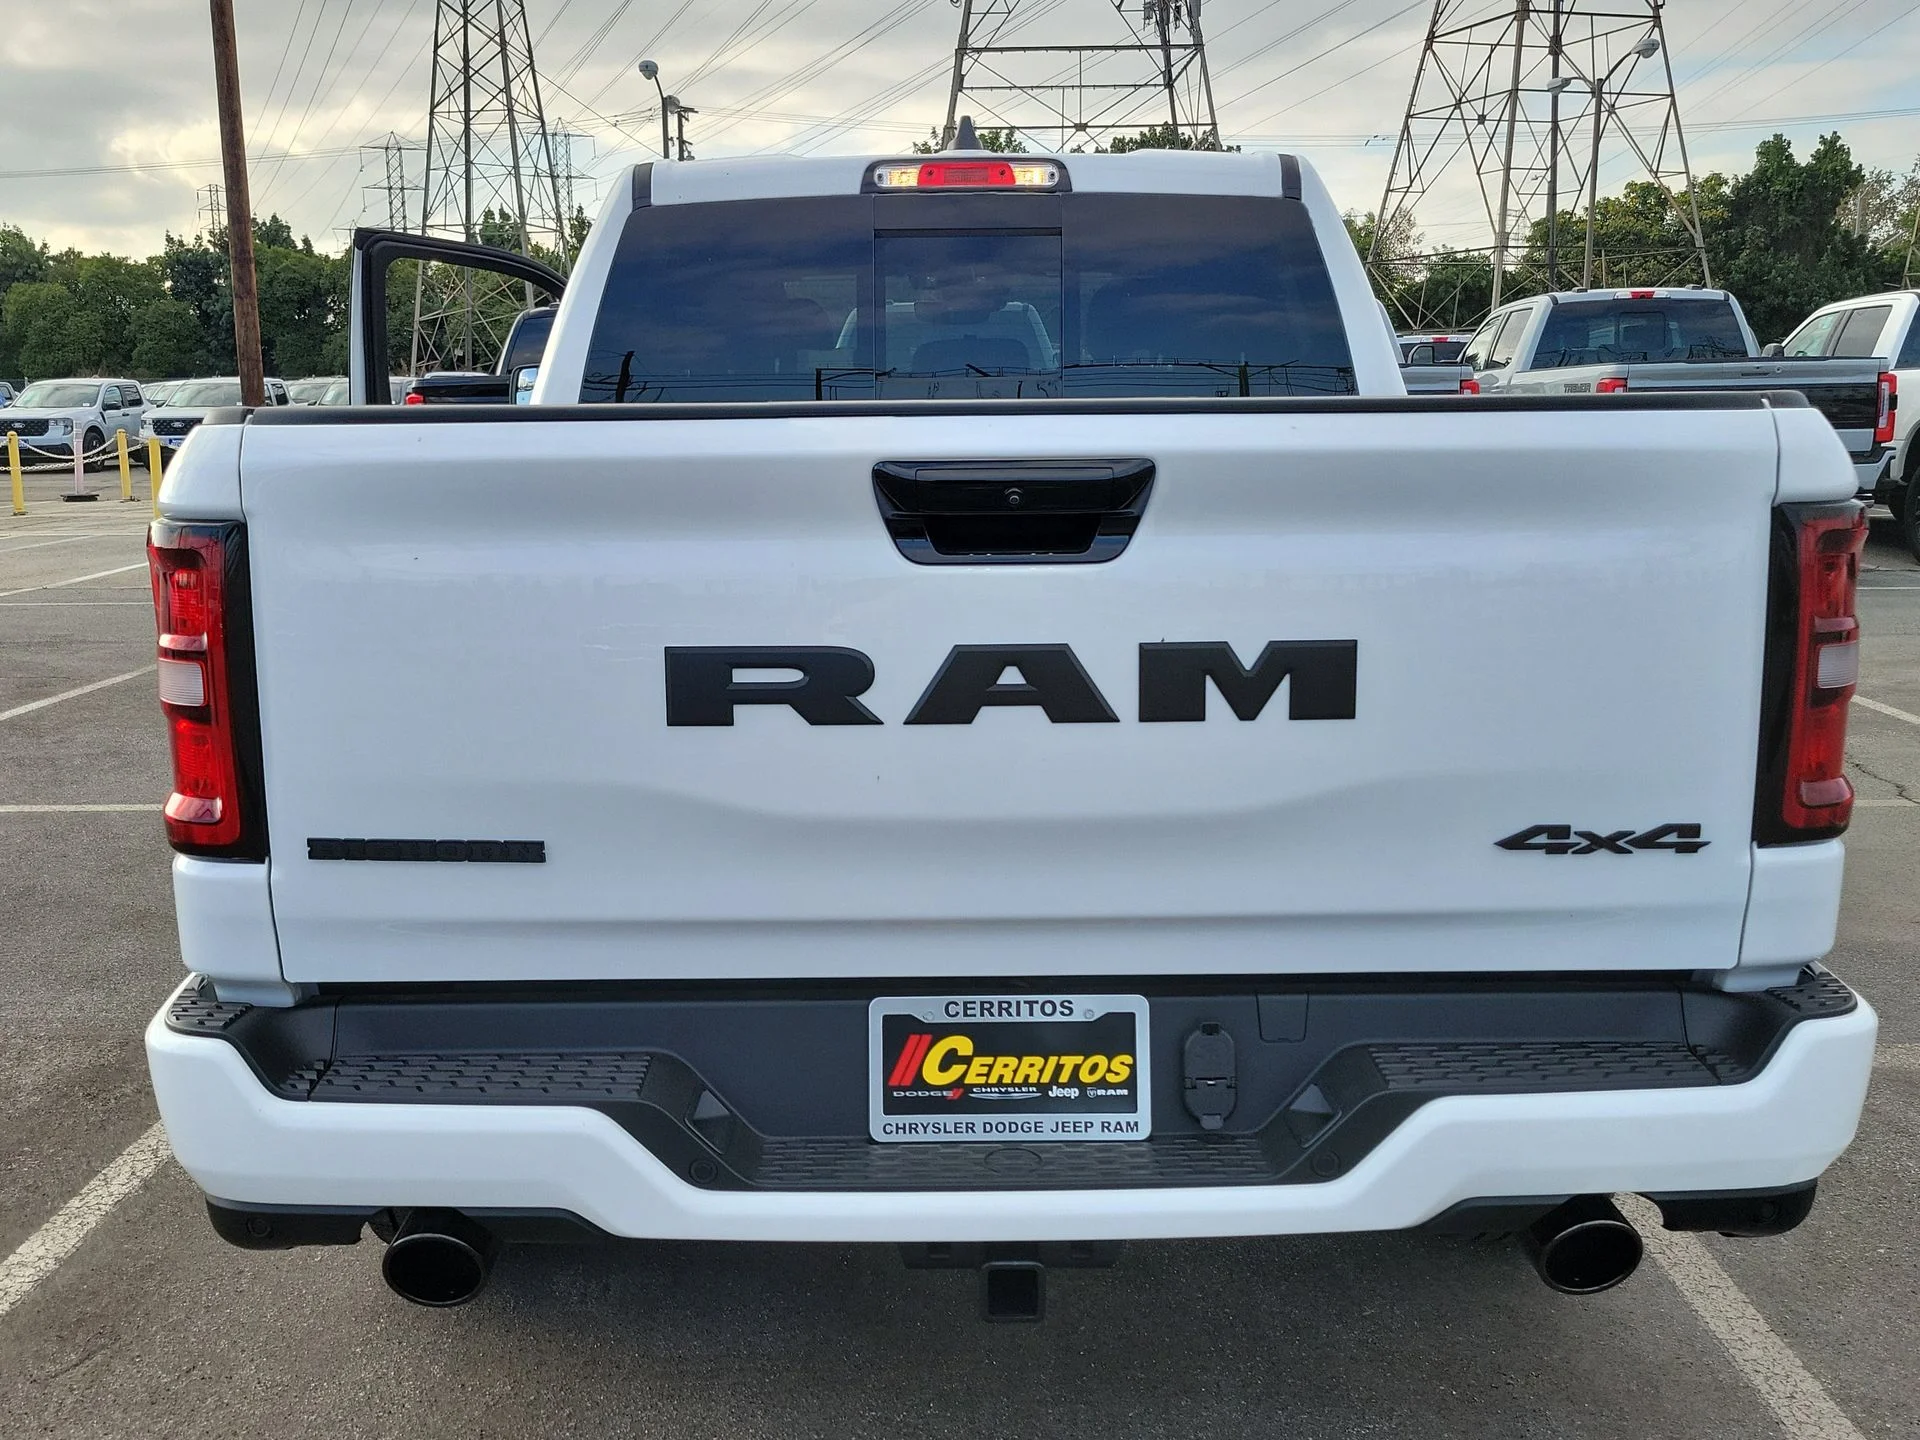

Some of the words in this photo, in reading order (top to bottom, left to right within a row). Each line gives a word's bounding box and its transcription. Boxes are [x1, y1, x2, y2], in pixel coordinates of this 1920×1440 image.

[664, 639, 1357, 726] RAM
[1494, 823, 1711, 855] 4x4
[944, 1000, 1074, 1017] CERRITOS
[922, 1035, 1133, 1086] CERRITOS
[893, 1090, 954, 1098] DODGE
[1048, 1085, 1079, 1099] Jeep
[1096, 1088, 1129, 1096] RAM
[882, 1121, 977, 1134] CHRYSLER
[982, 1121, 1044, 1134] DODGE
[1050, 1121, 1094, 1133] JEEP
[1100, 1121, 1139, 1133] RAM
